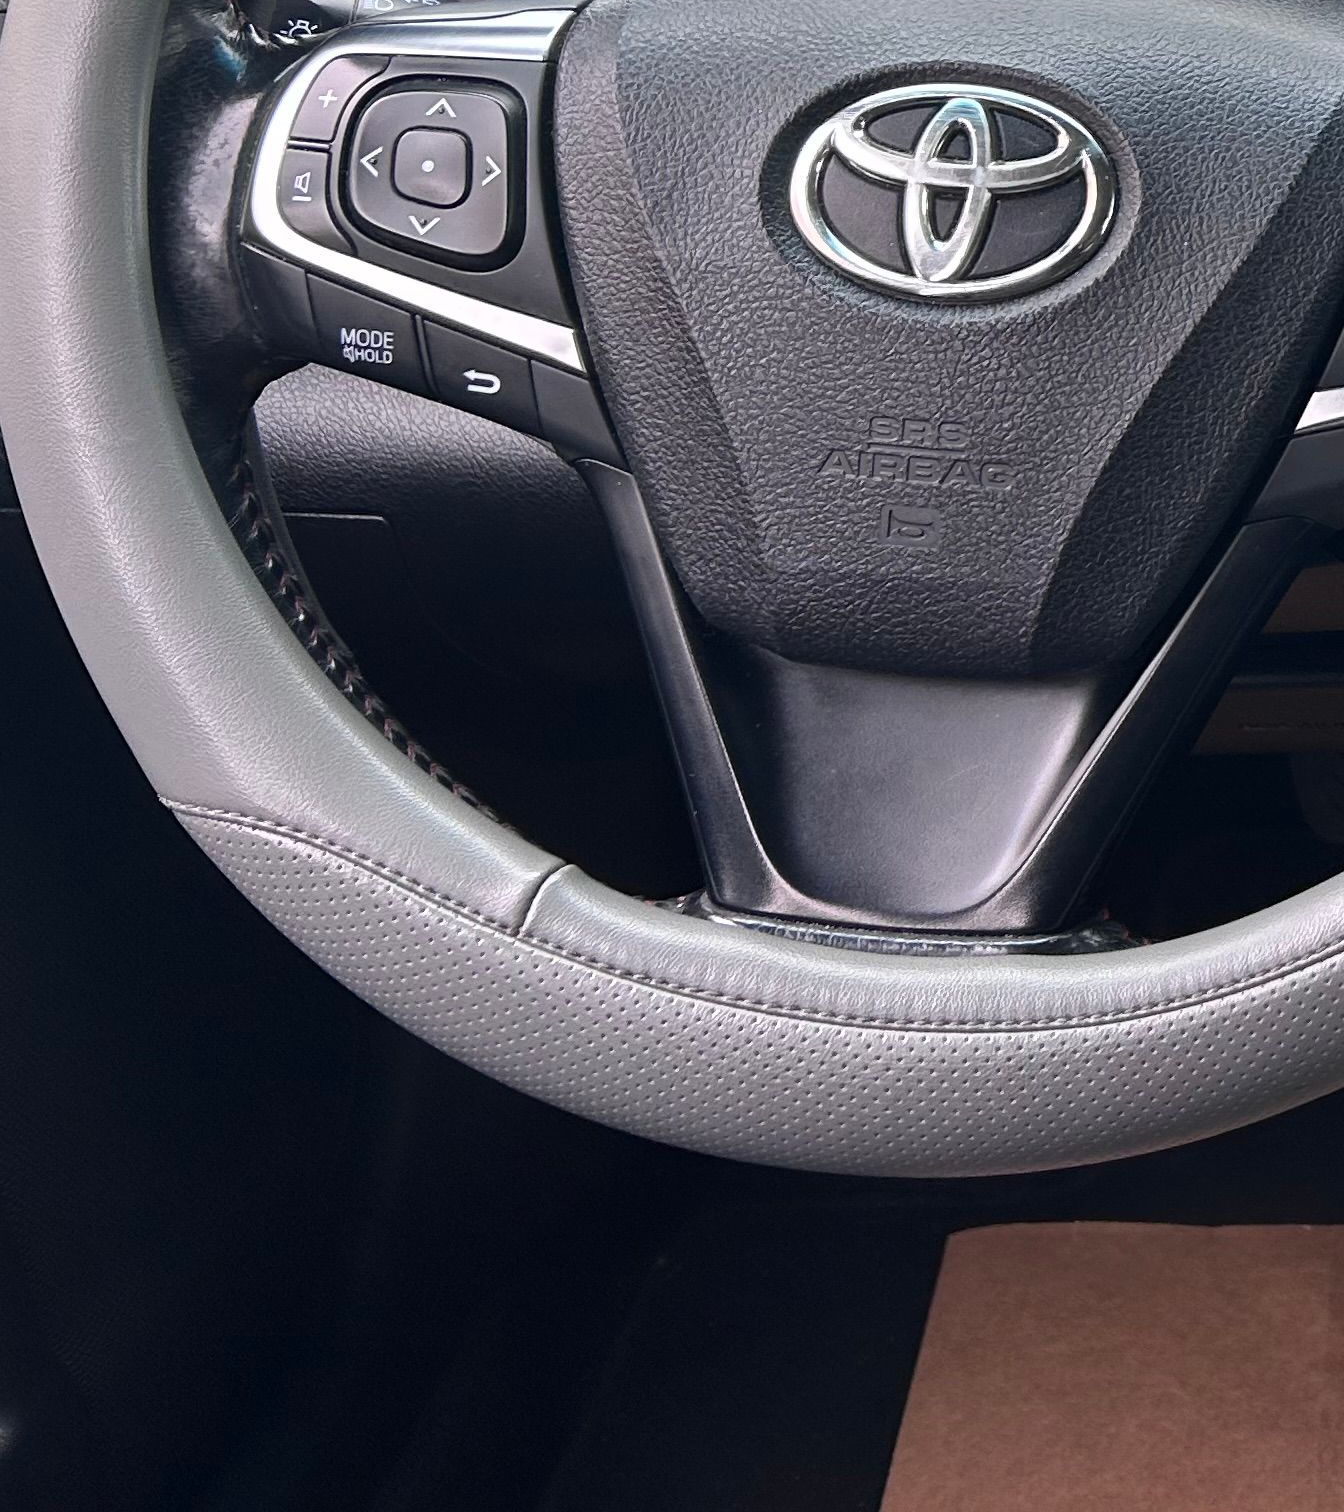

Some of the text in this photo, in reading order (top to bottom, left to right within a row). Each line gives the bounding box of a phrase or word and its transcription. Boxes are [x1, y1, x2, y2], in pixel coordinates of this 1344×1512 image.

[341, 327, 395, 350] MODE
[354, 347, 394, 364] HOLD
[867, 415, 972, 448] SRS
[816, 448, 1015, 489] AIRBAG
